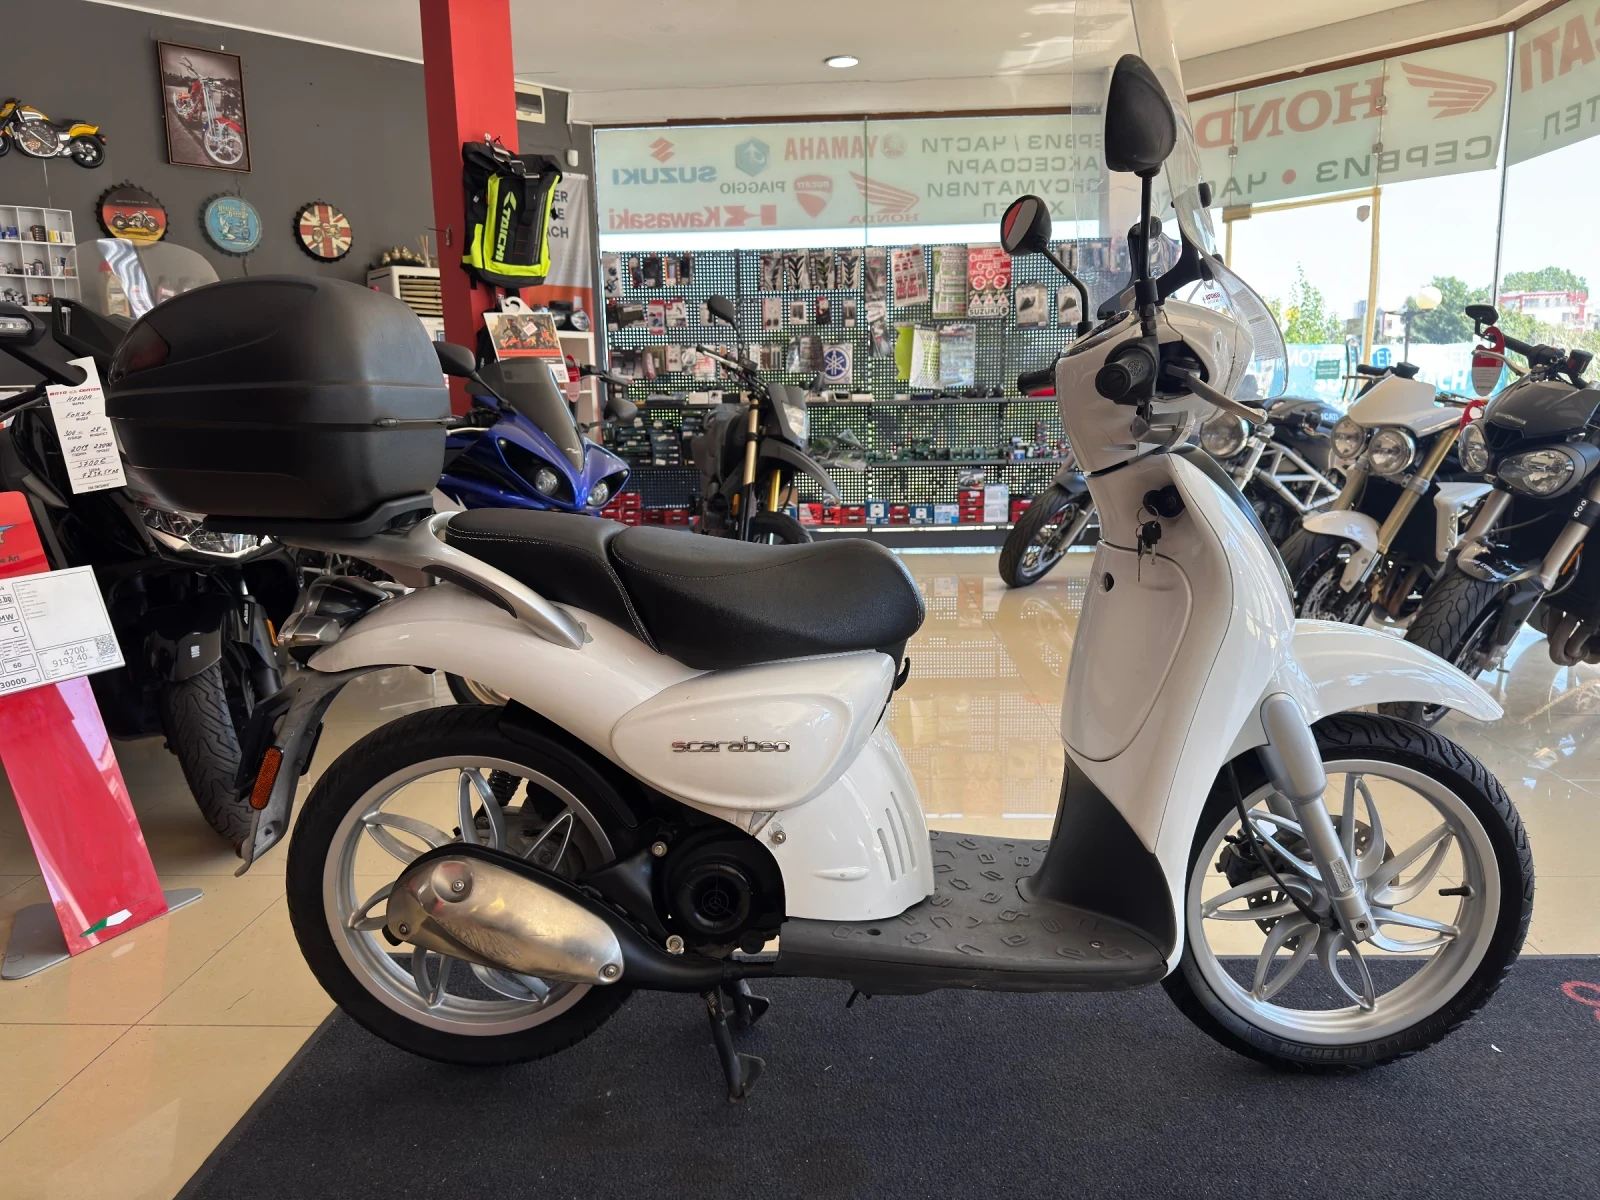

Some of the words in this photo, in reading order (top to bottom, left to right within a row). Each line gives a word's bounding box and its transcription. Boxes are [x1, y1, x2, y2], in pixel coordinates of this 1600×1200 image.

[495, 207, 512, 262] TAICHI
[968, 307, 999, 317] SUZUKI
[63, 645, 85, 656] 4700
[52, 652, 88, 668] 9192.40
[672, 735, 791, 753] scarabeo
[1280, 1042, 1363, 1060] MICHELIN
